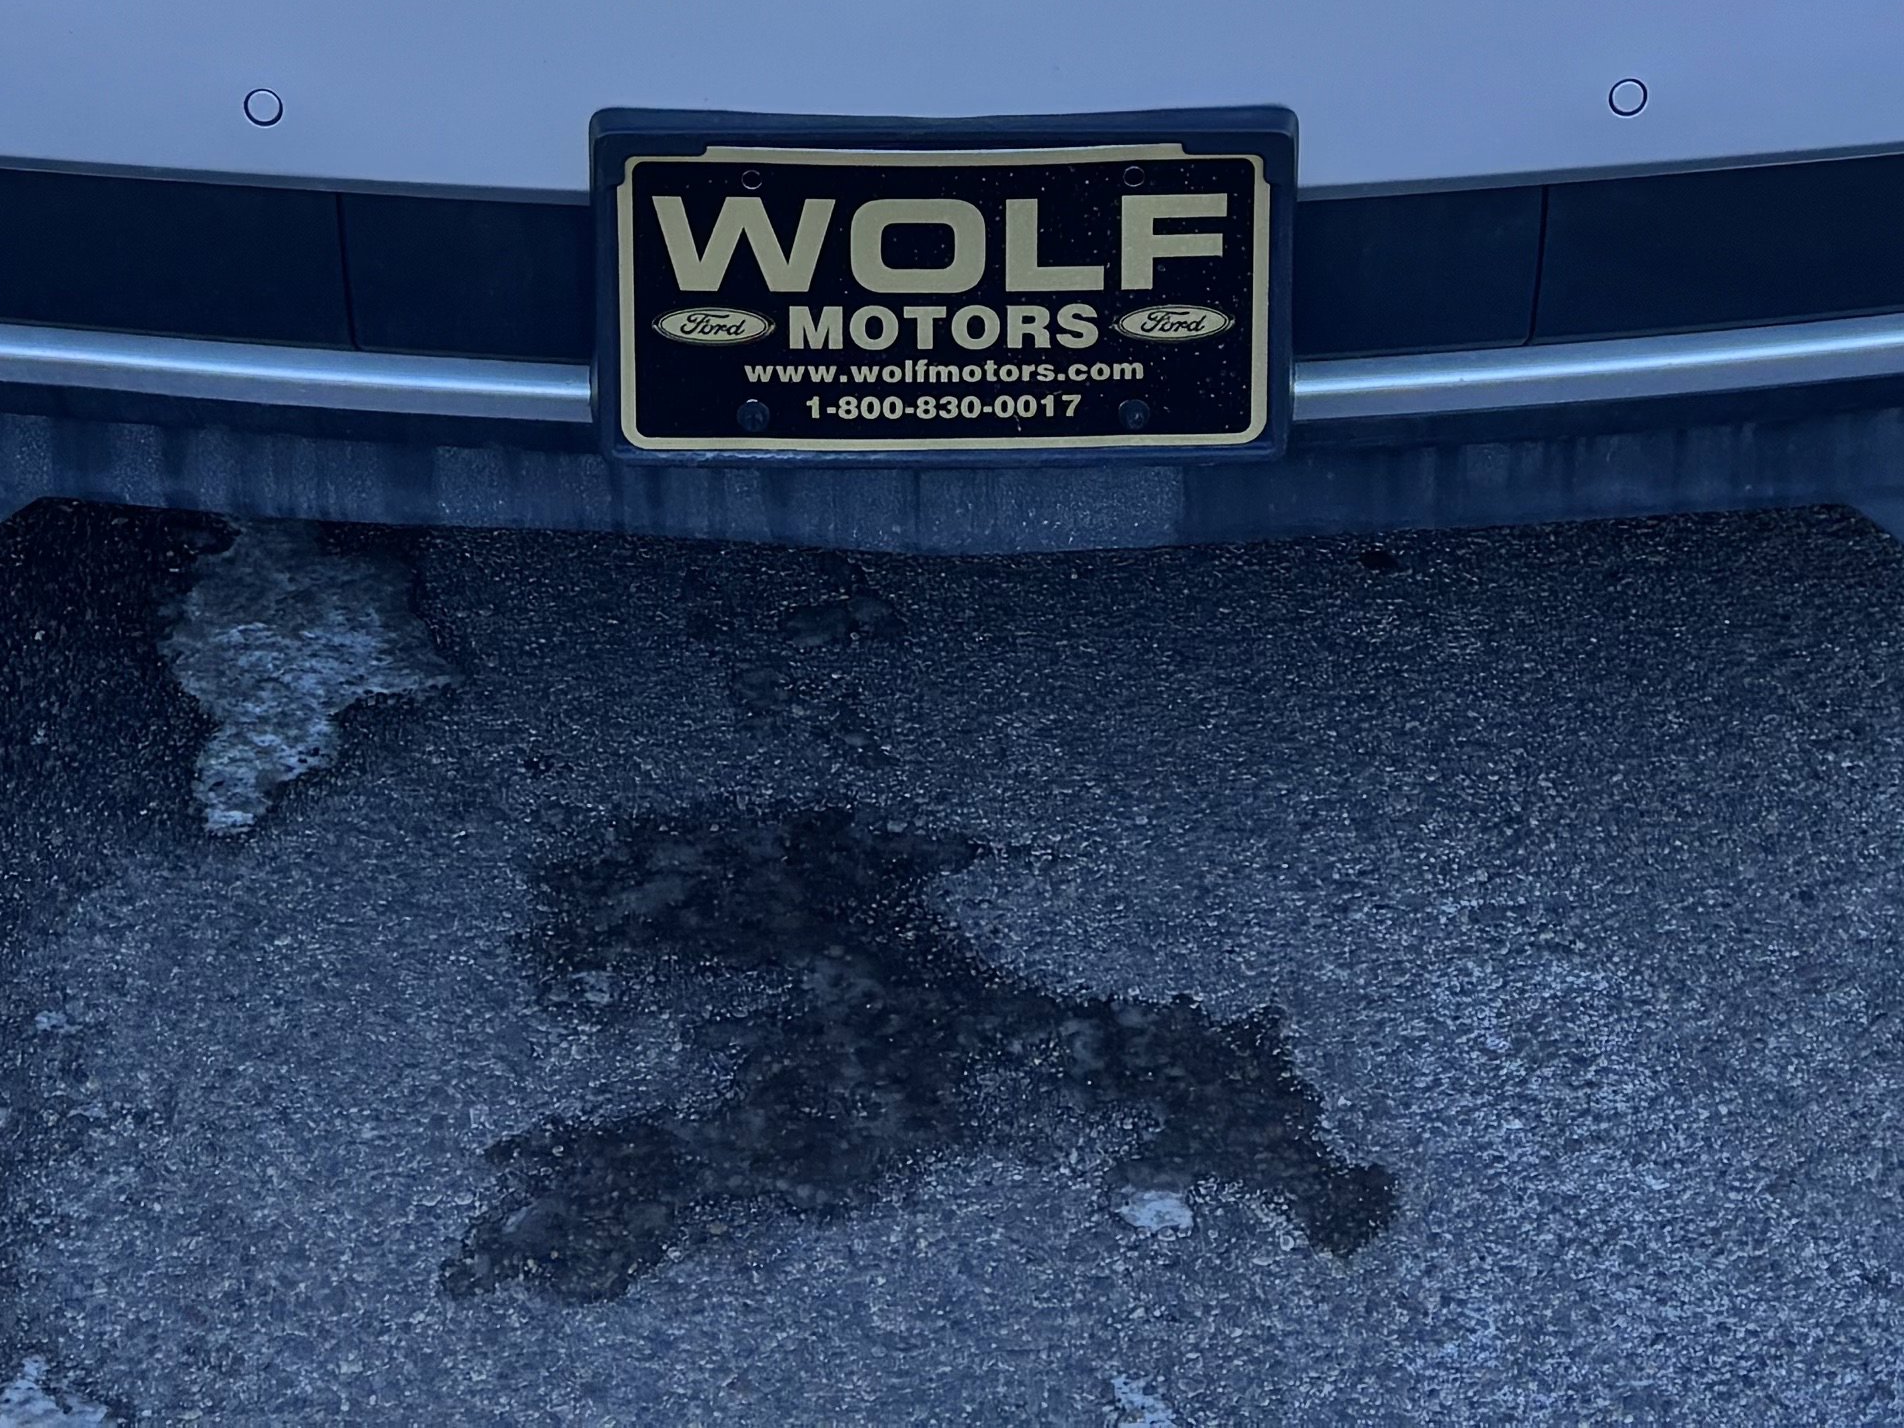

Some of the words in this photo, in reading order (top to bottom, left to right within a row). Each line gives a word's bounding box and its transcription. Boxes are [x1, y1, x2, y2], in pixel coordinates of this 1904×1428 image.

[651, 192, 1228, 293] WOLF
[788, 304, 1100, 350] MOTORS
[743, 358, 1145, 384] www.wolfmotors.com
[805, 394, 1083, 420] 1-800-830-0017
